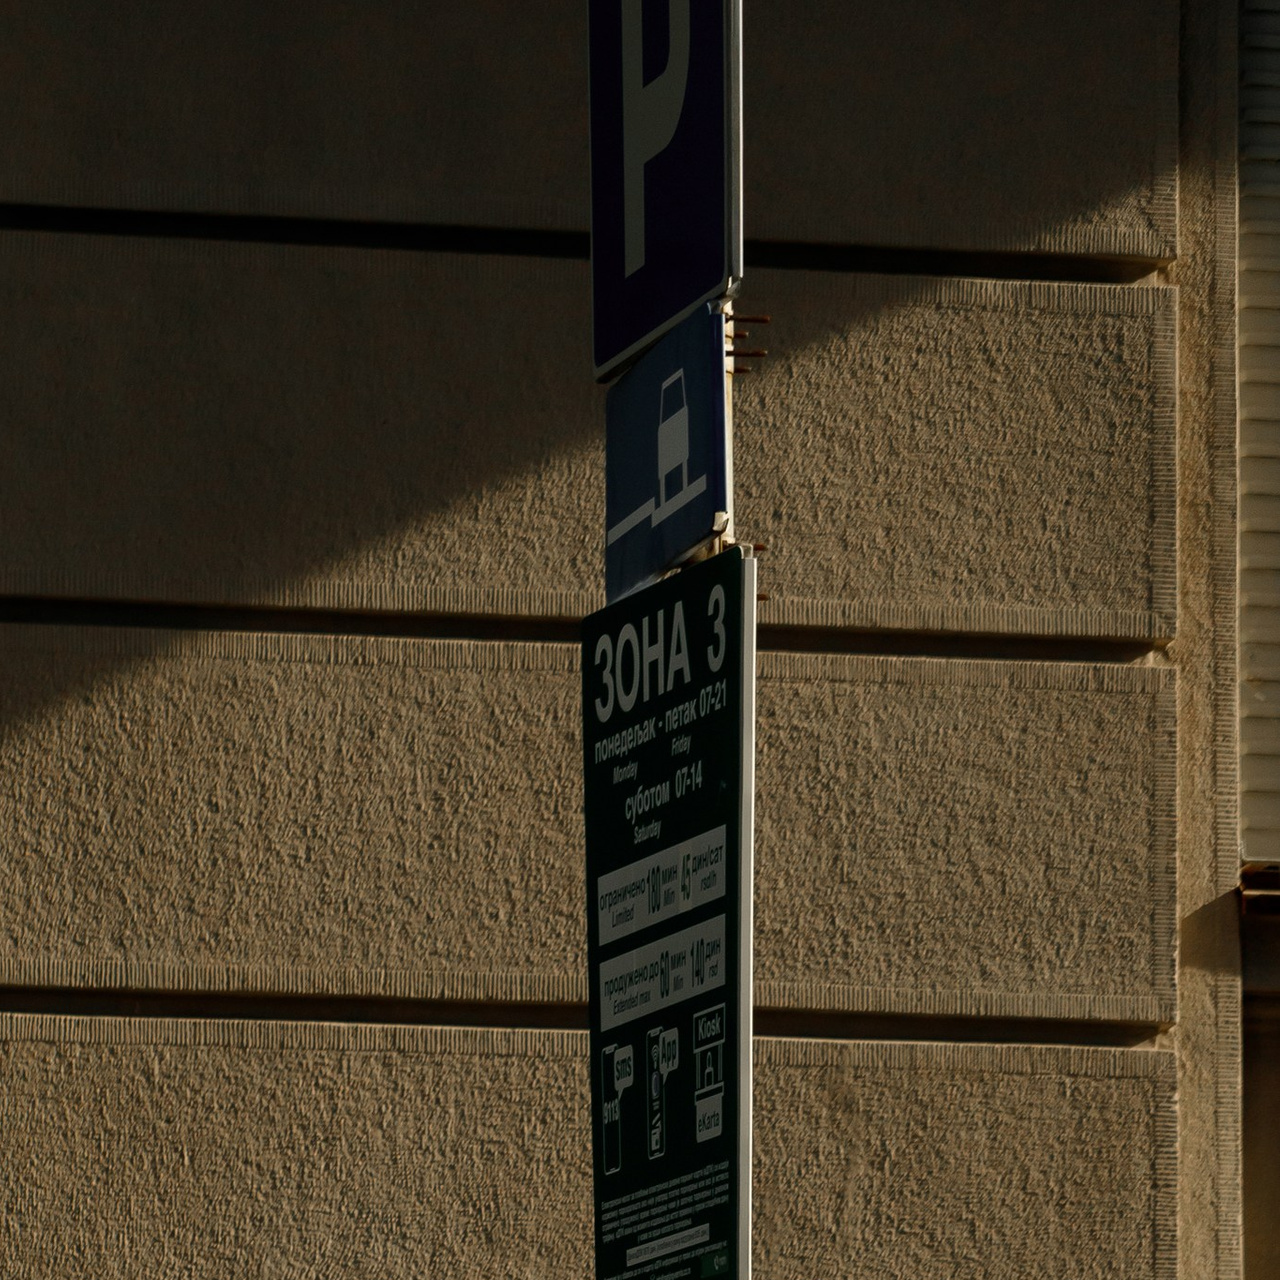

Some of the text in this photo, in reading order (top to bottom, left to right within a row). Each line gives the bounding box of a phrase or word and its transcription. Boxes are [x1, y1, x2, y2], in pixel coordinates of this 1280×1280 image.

[621, 0, 691, 279] P
[594, 583, 727, 723] ЗОНА 3
[594, 716, 657, 765] понедељак
[664, 698, 698, 734] петак
[699, 678, 728, 718] 07-21
[612, 734, 693, 785] Monday Friday
[624, 759, 703, 825] суботом 07-14
[633, 819, 662, 845] Saturday
[599, 844, 724, 915] ограничено 180 мин 45 дин/сат
[611, 903, 635, 929] Limited
[663, 888, 676, 907] Min
[604, 937, 721, 999] продужено до 60 мин 140 дин
[613, 993, 638, 1016] Extended
[698, 1013, 721, 1041] Kiosk
[660, 1036, 677, 1070] App
[603, 1097, 620, 1125] 9113
[697, 1111, 721, 1134] eKarta
